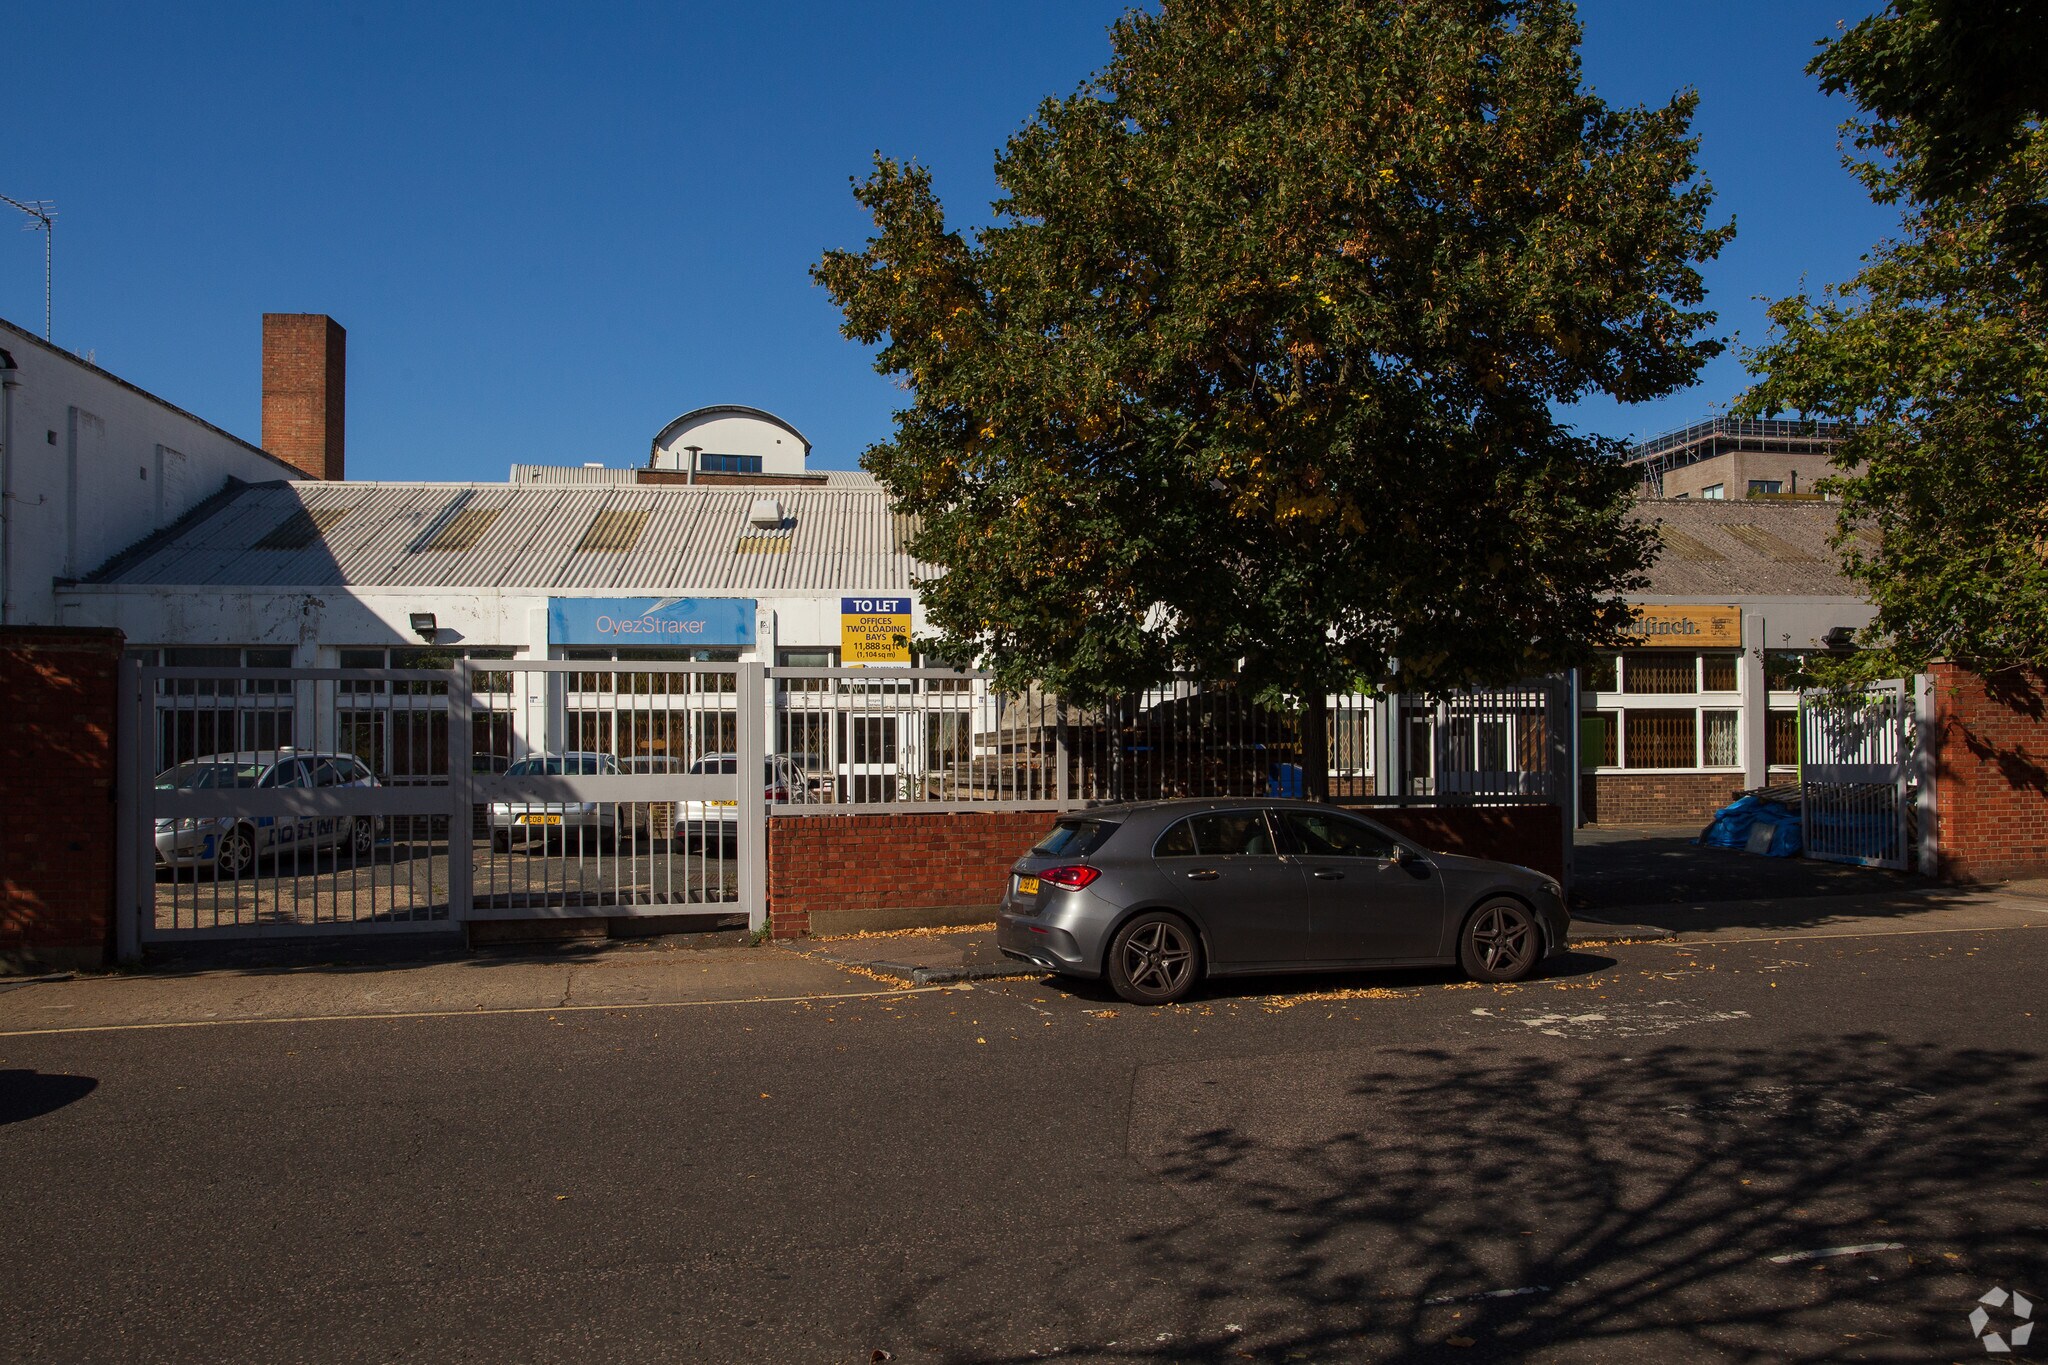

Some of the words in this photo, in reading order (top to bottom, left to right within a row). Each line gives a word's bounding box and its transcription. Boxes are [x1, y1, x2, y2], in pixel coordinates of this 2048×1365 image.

[853, 600, 872, 612] TO
[876, 600, 899, 612] LET
[596, 615, 706, 636] OyezStraker
[854, 642, 880, 650] 11,888
